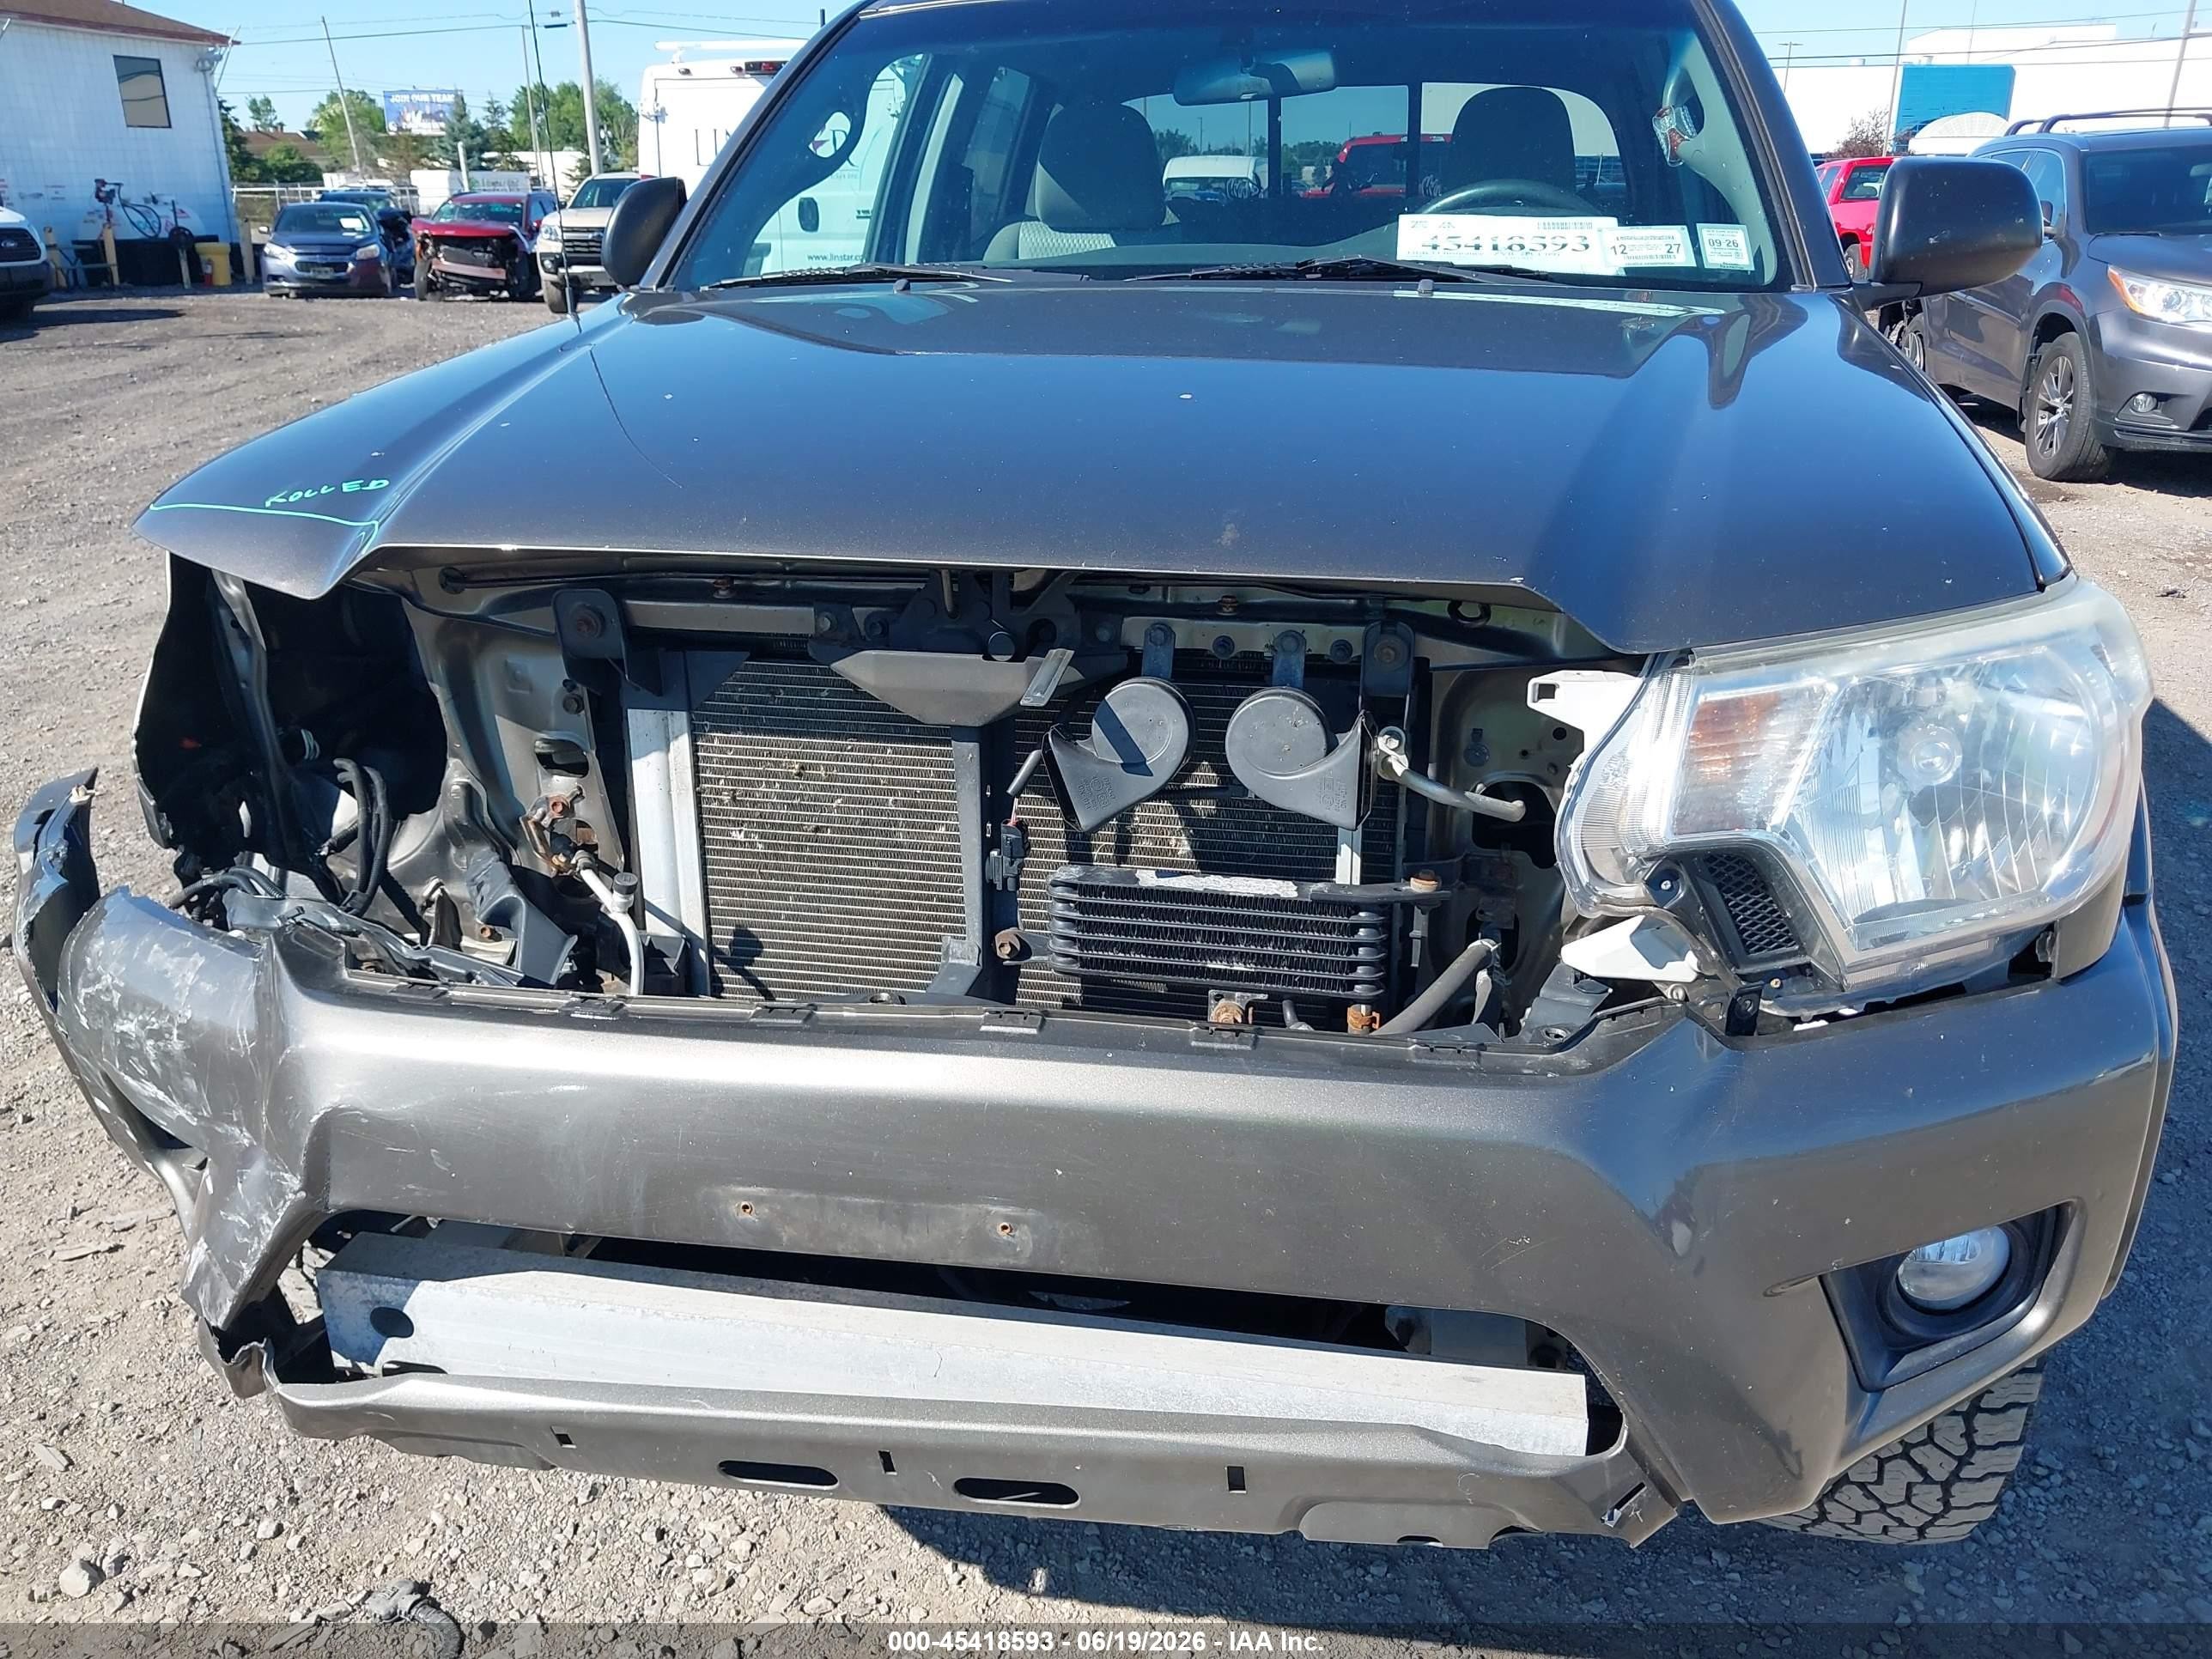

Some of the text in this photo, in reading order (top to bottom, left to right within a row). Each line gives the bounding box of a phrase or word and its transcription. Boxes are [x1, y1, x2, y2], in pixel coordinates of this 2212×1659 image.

[1421, 234, 1590, 252] 45418593
[1610, 244, 1628, 255] 12
[1664, 243, 1681, 254] 27
